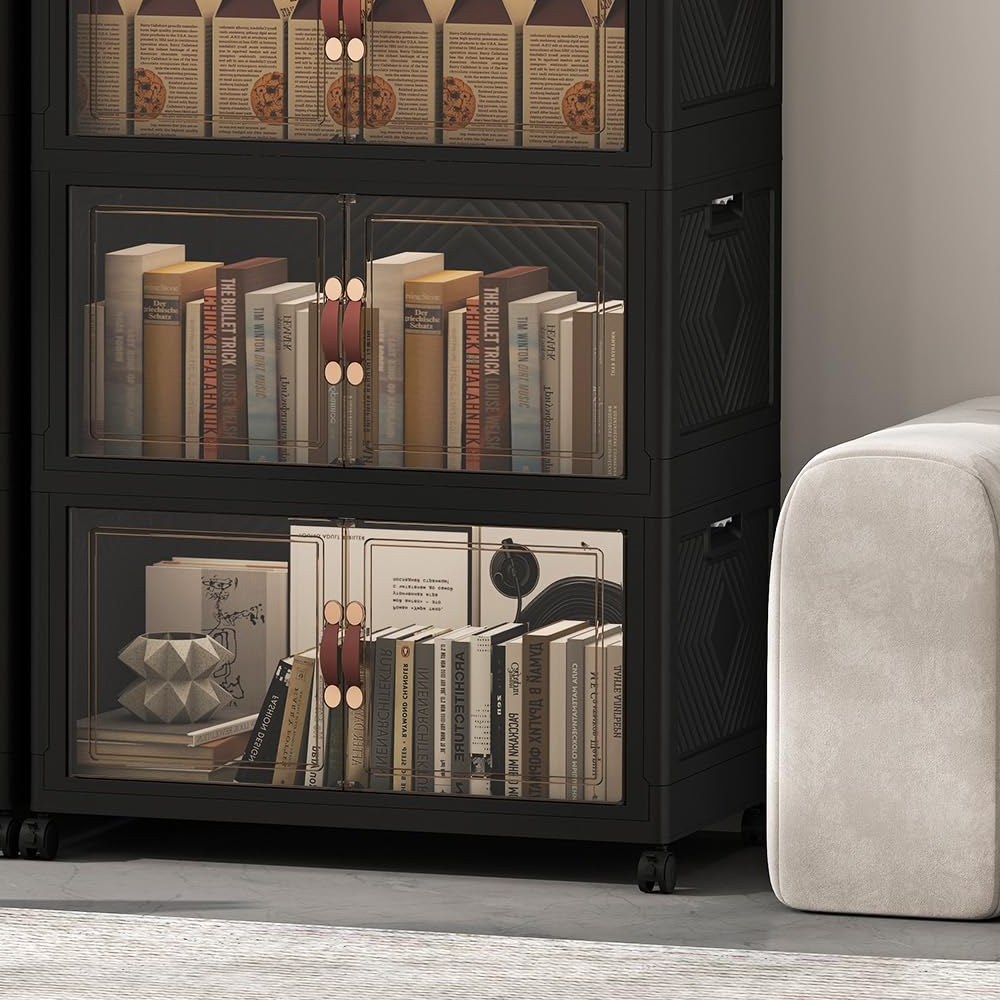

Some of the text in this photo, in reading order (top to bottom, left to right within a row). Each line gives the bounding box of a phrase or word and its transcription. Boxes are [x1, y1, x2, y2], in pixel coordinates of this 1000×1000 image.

[220, 278, 236, 296] THE
[483, 287, 499, 305] THE
[221, 298, 236, 334] BULLET
[254, 307, 264, 321] TIM
[484, 307, 500, 343] BULLET
[517, 316, 528, 330] TIM
[221, 336, 237, 366] TRICK
[254, 323, 265, 353] WINTON
[517, 332, 528, 362] WINTON
[484, 346, 500, 376] TRICK
[255, 374, 266, 399] MUSIC
